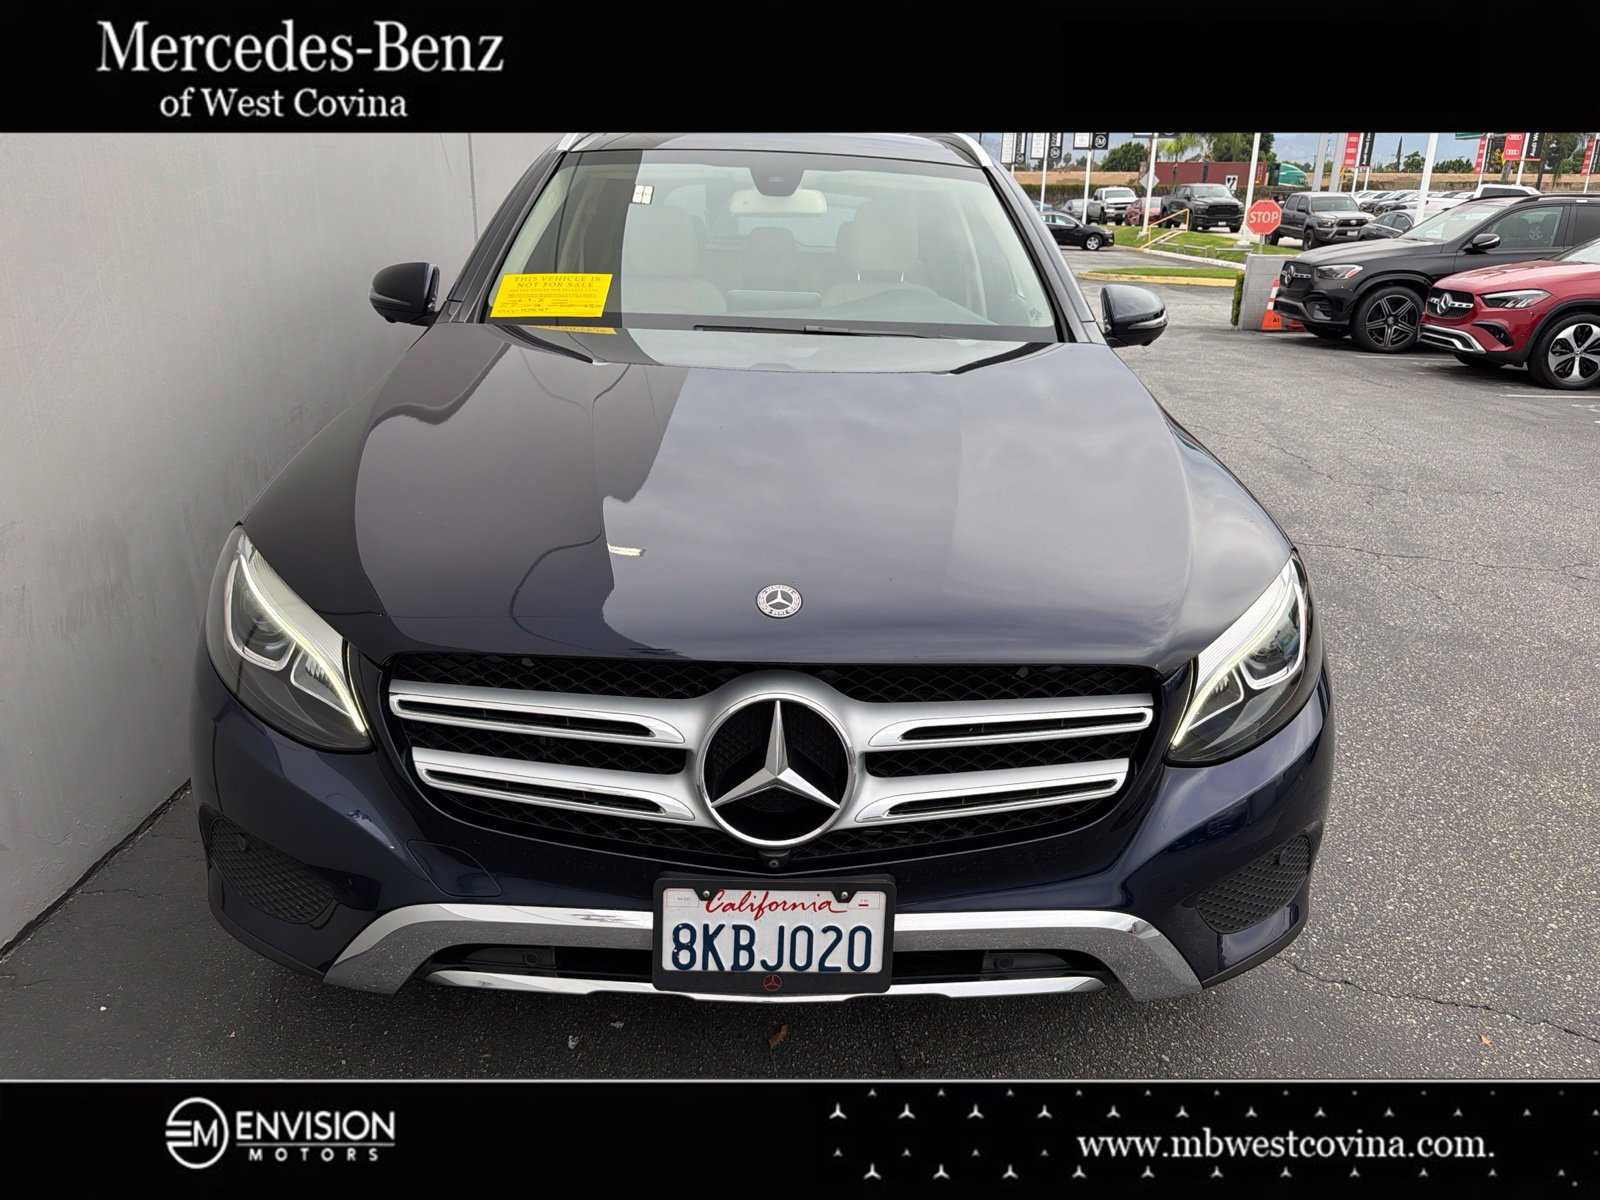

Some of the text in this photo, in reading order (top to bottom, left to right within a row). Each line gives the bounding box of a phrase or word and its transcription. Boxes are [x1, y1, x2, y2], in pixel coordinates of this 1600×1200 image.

[1249, 211, 1279, 224] STOP
[705, 888, 848, 921] California
[671, 922, 873, 972] 8KBJ020
